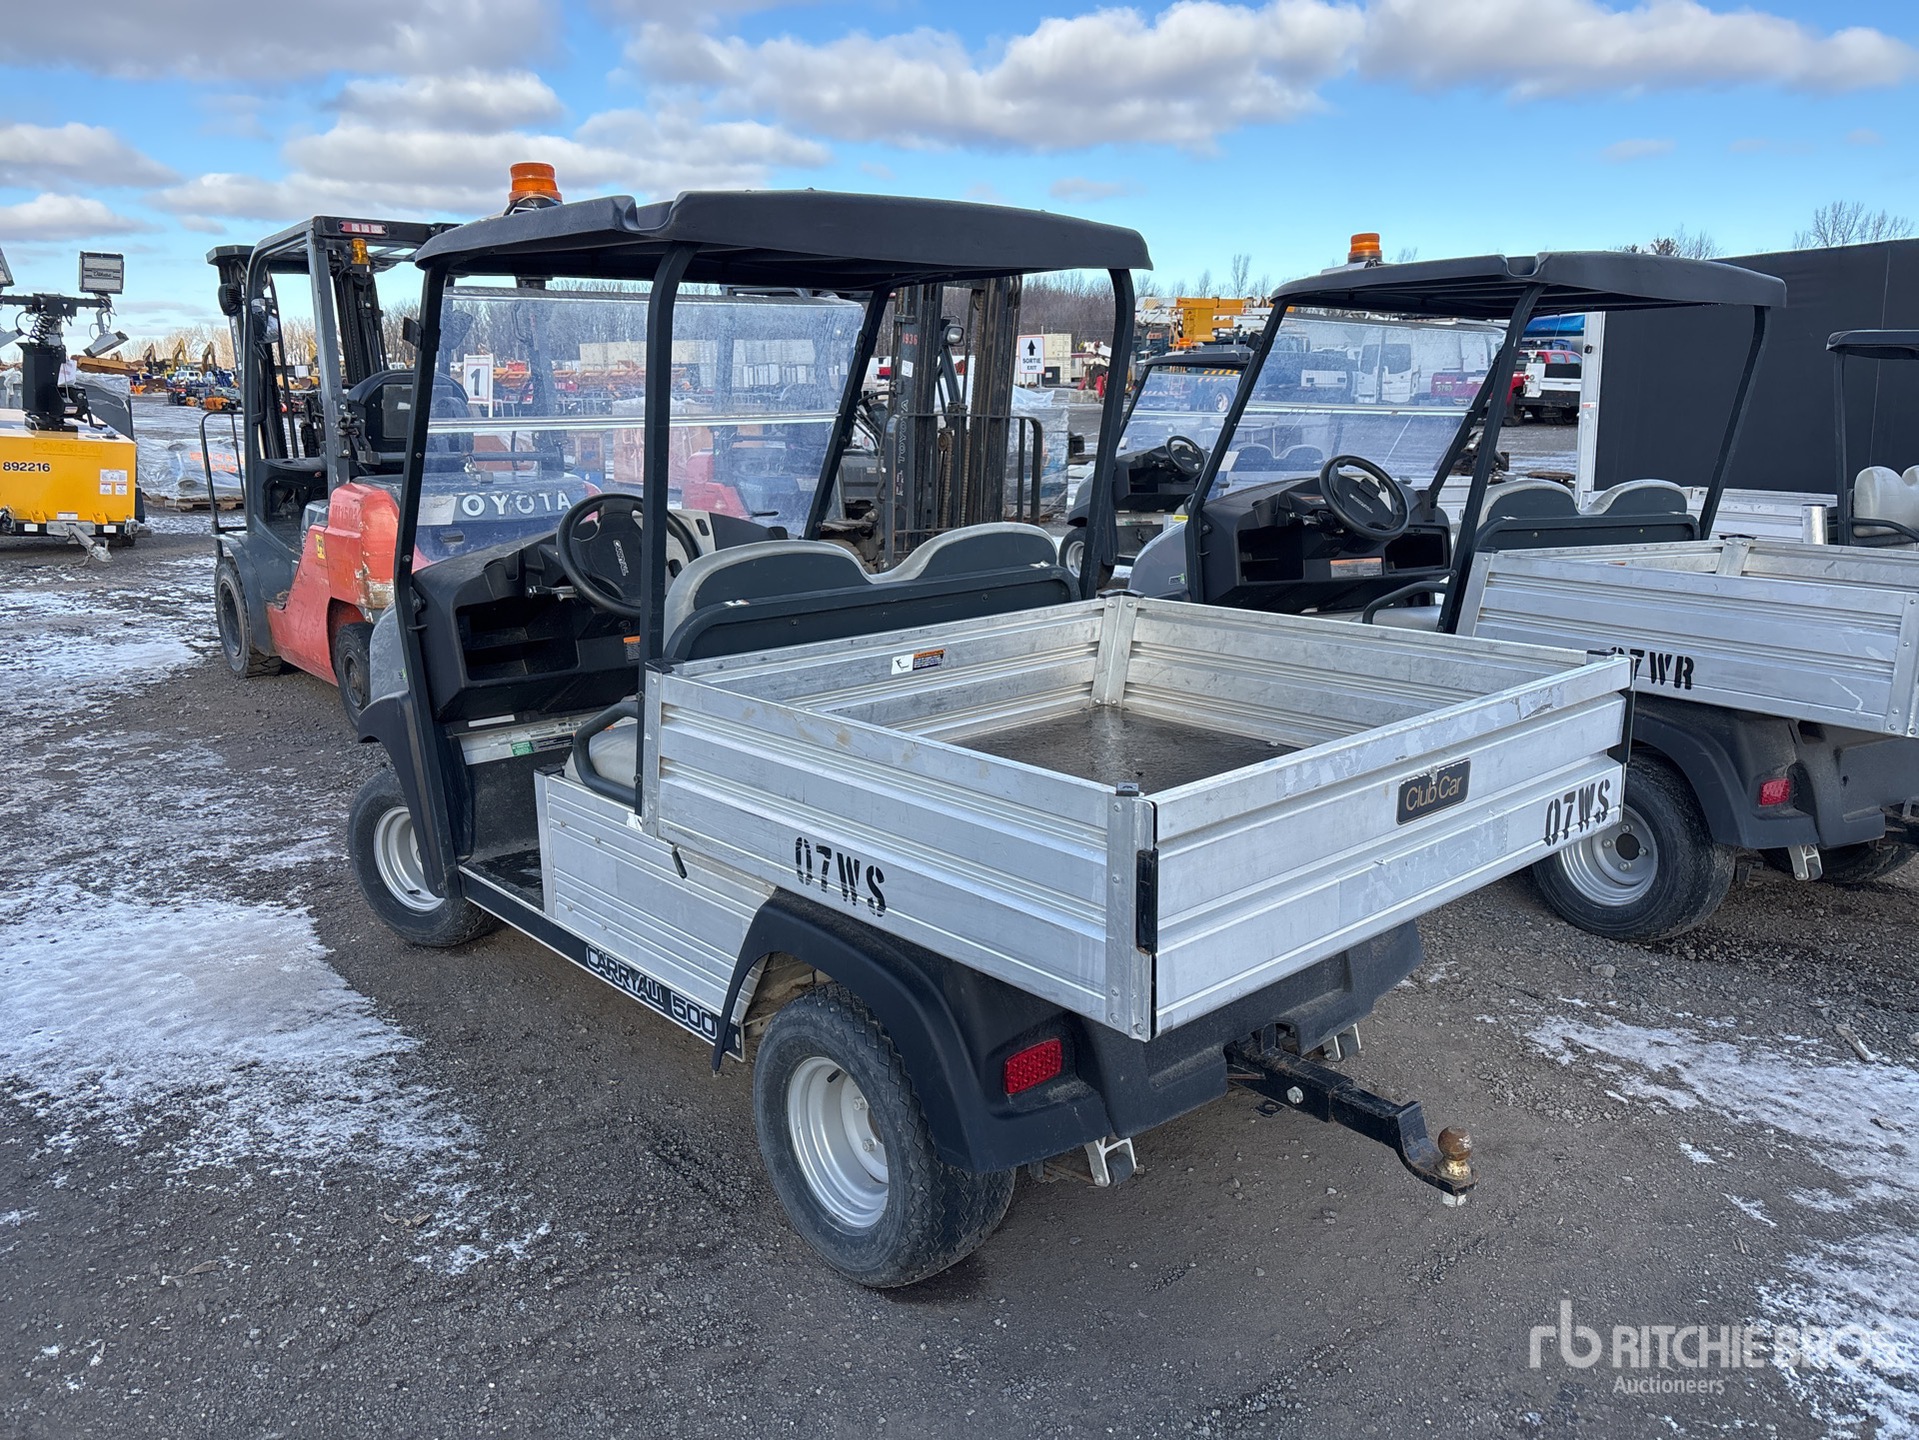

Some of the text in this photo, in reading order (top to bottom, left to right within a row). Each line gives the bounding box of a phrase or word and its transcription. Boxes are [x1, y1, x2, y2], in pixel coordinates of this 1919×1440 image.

[470, 368, 481, 397] 1
[2, 461, 51, 473] 892216
[461, 490, 573, 517] OYOTA
[1610, 646, 1695, 690] 7WR
[1405, 775, 1463, 812] Club Car
[1543, 778, 1611, 847] 07WS
[795, 836, 887, 918] 07WS
[670, 990, 718, 1040] 500
